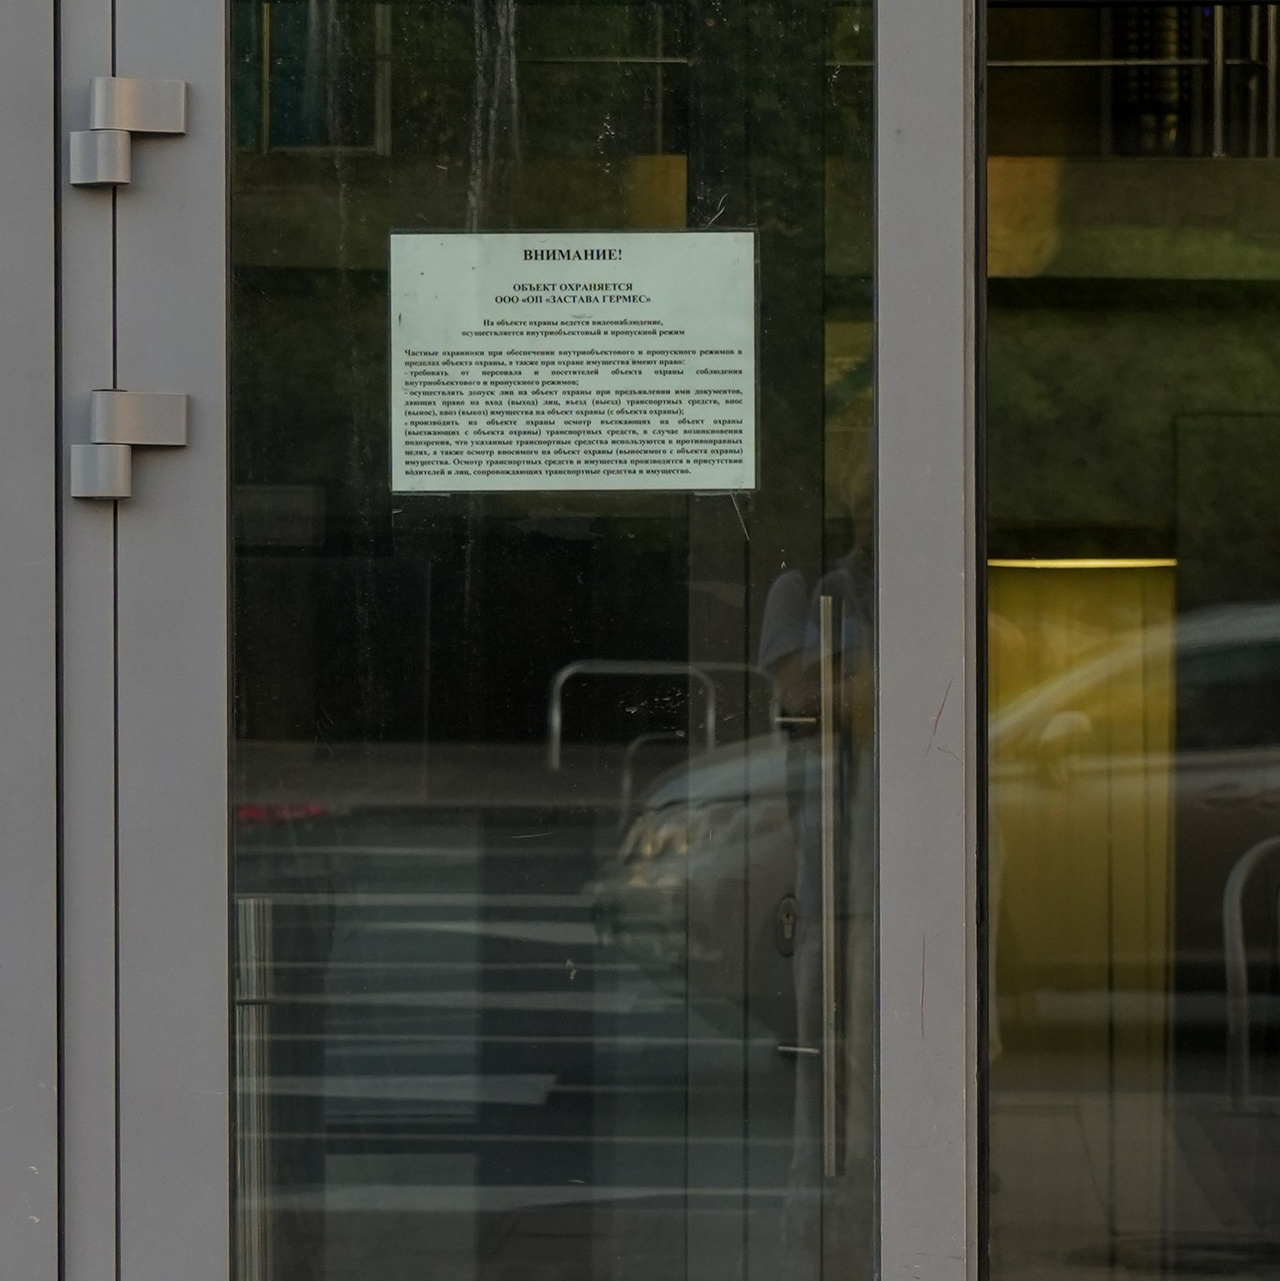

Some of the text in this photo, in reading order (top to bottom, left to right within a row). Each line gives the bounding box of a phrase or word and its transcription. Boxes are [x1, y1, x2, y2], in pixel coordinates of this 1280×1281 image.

[523, 248, 622, 261] ВНИМАНИЕ!
[512, 282, 633, 292] ОБЪЕКТ ОХРАНЯЕТСЯ
[494, 294, 652, 305] ООО «ОП «ЗАСТАВА ГЕРМЕС»
[483, 319, 495, 327] На
[496, 318, 527, 327] объекте
[528, 320, 559, 328] охраны
[461, 330, 525, 338] осуществляется
[525, 328, 602, 338] внутриобъектовый
[610, 328, 658, 338] пропускной
[658, 329, 685, 338] режим
[404, 349, 439, 357] Частные
[441, 350, 485, 358] охранники
[487, 350, 504, 358] при
[505, 348, 555, 357] обеспечении
[558, 348, 635, 358] внутриобъектового
[646, 349, 697, 358] пропускного
[699, 349, 735, 357] режимов
[404, 360, 440, 369] пределах
[441, 358, 473, 367] объекта
[540, 360, 556, 368] при
[557, 360, 585, 368] охране
[585, 359, 630, 368] имущества
[631, 358, 658, 366] имеют
[409, 368, 450, 378] требовать
[481, 370, 523, 378] персонала
[550, 368, 600, 376] посетителей
[610, 367, 643, 376] объекта
[653, 369, 684, 377] охраны
[695, 367, 743, 376] соблюдения
[404, 378, 482, 388] внутриобъектового
[489, 380, 540, 388] пропускного
[409, 390, 465, 398] осуществлять
[467, 390, 496, 398] допуск
[530, 387, 558, 396] объект
[561, 389, 592, 398] охраны
[595, 389, 611, 397] при
[614, 389, 671, 397] предъявлении
[441, 400, 466, 408] право
[484, 399, 503, 407] вход
[507, 398, 539, 407] (выход)
[591, 398, 622, 407] (выезд)
[626, 399, 683, 407] транспортных
[457, 408, 489, 417] (вывоз)
[489, 409, 534, 418] имущества
[546, 408, 574, 416] объект
[575, 409, 606, 418] охраны
[606, 408, 615, 417] (с
[615, 407, 648, 416] объекта
[409, 419, 460, 428] производить
[485, 418, 518, 426] объекте
[525, 419, 556, 428] охраны
[563, 419, 592, 427] осмотр
[677, 417, 705, 425] объект
[712, 418, 743, 427] охраны
[404, 428, 460, 437] (выезжающих
[472, 428, 505, 436] объекта
[508, 428, 542, 438] охраны)
[545, 429, 603, 438] транспортных
[652, 429, 679, 437] случае
[470, 439, 513, 448] указанные
[515, 439, 572, 448] транспортные
[573, 439, 609, 447] средства
[610, 439, 666, 447] используются
[675, 438, 743, 447] противоправных
[466, 449, 495, 458] осмотр
[553, 447, 581, 456] объект
[583, 449, 614, 457] охраны
[615, 448, 668, 456] (выносимого
[676, 447, 708, 455] объекта
[710, 447, 744, 456] охраны)
[452, 457, 484, 467] Осмотр
[485, 459, 542, 467] транспортных
[544, 459, 575, 467] средств
[583, 459, 628, 467] имущества
[629, 458, 684, 467] производится
[693, 458, 743, 467] присутствии
[404, 468, 446, 476] водителей
[472, 469, 543, 478] сопровождающих
[544, 469, 601, 477] транспортные
[602, 468, 637, 477] средства
